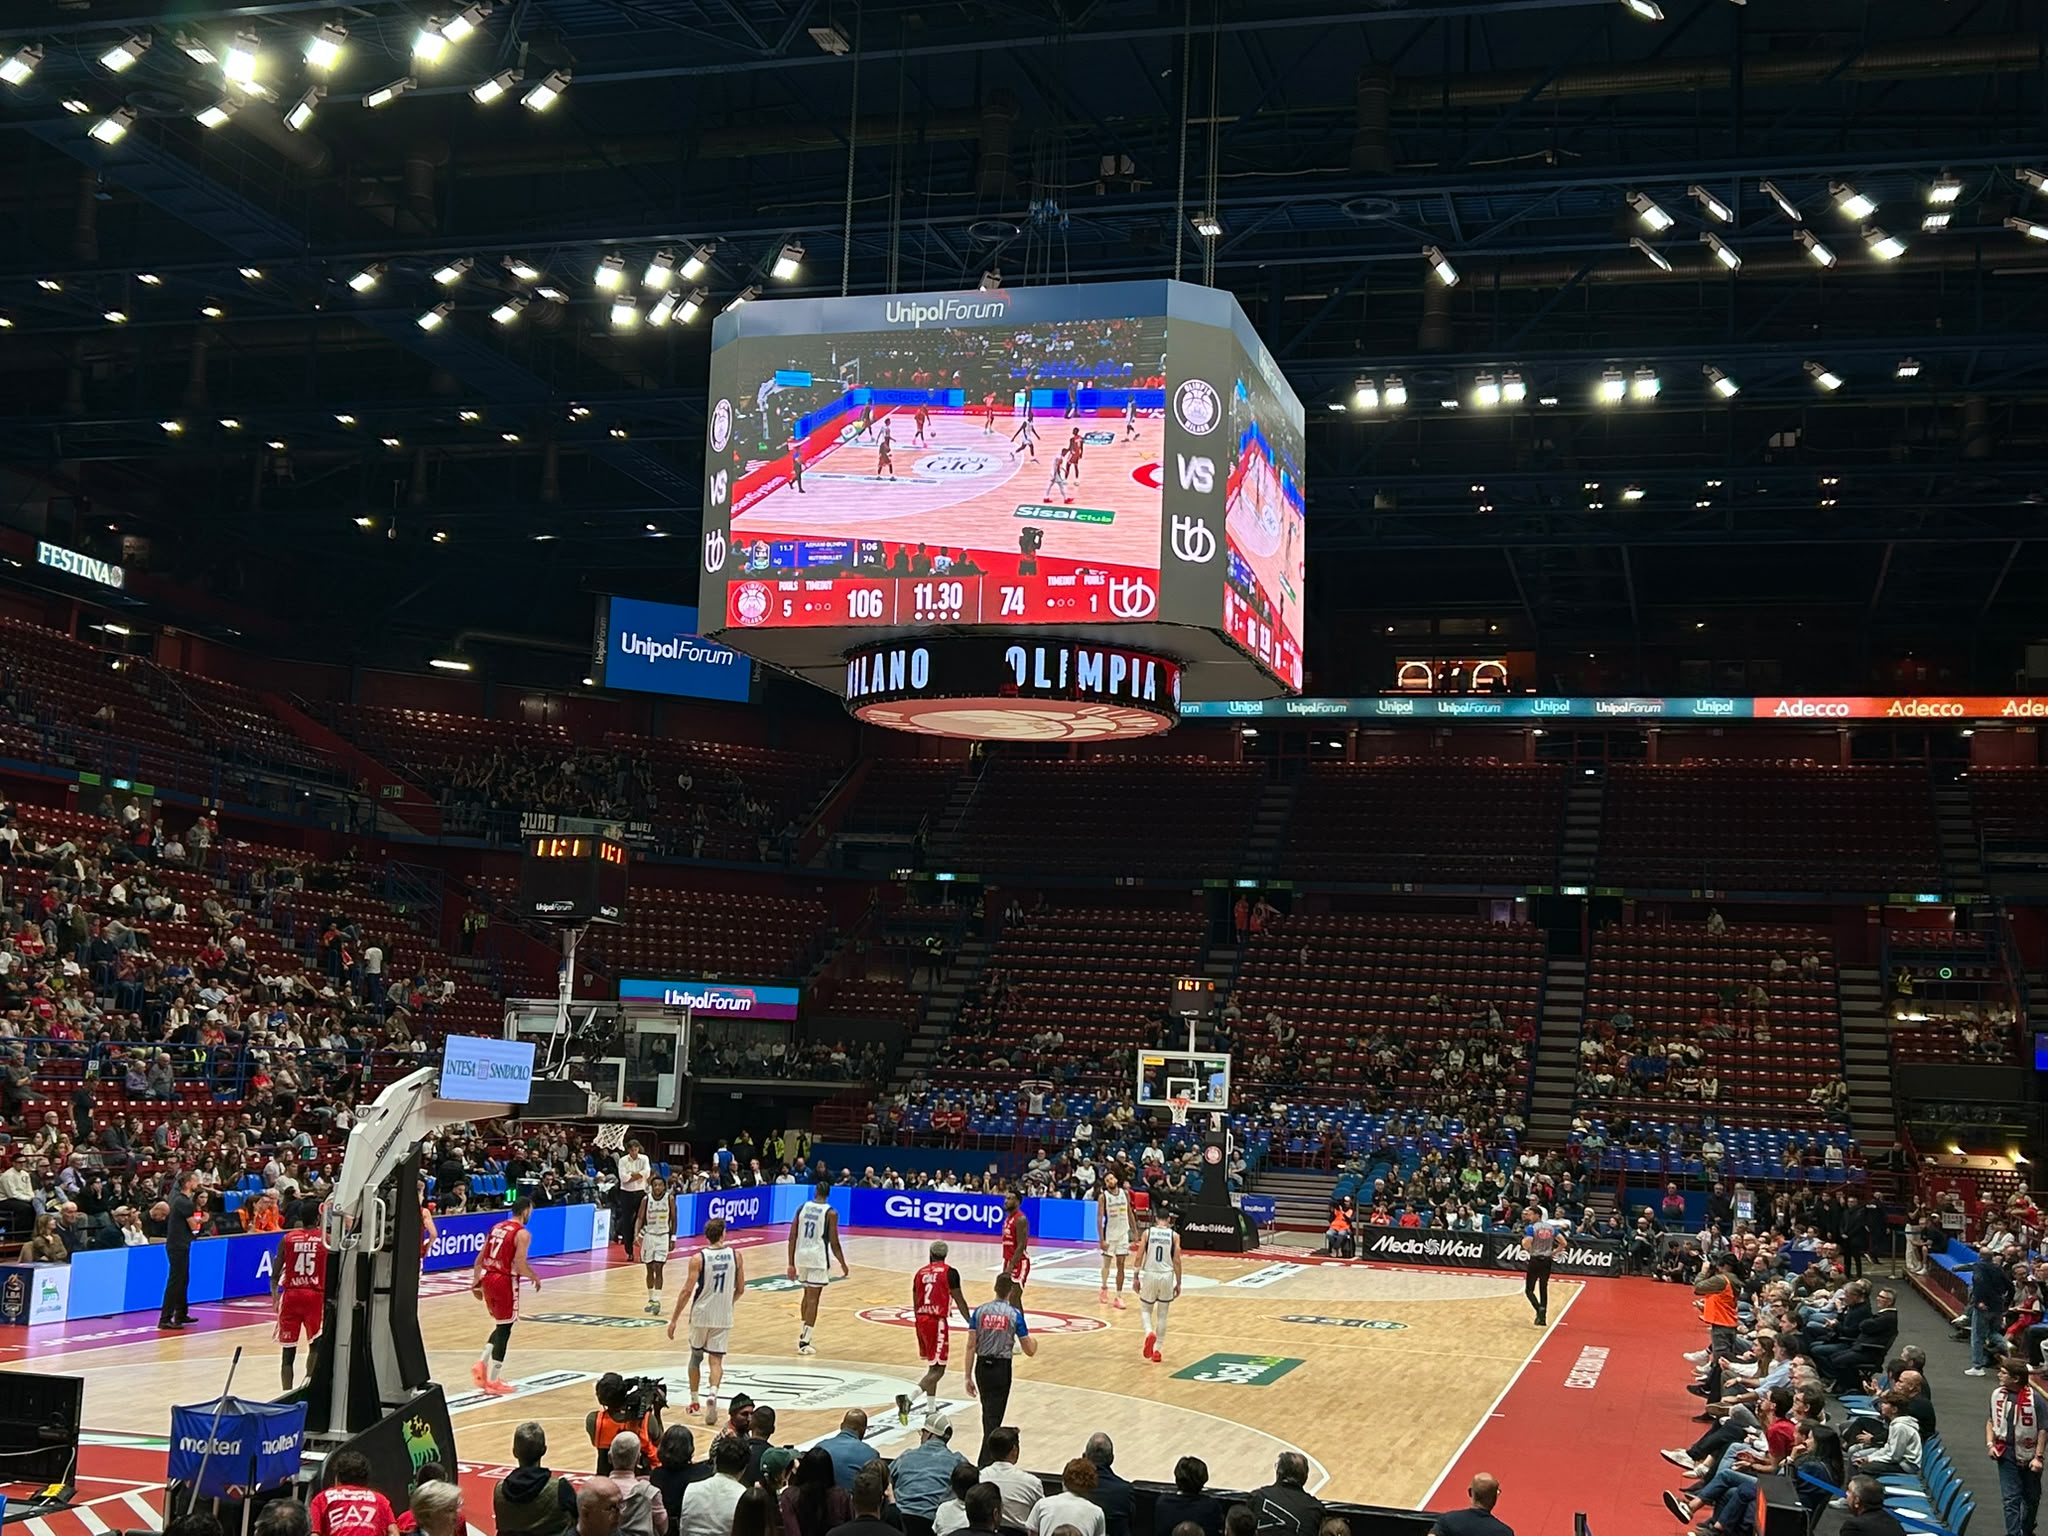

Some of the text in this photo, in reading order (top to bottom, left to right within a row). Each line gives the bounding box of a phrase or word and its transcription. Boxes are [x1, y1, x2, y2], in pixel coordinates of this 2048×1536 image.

[886, 301, 1004, 328] UnipolForum
[1177, 453, 1215, 493] VS
[709, 469, 727, 506] VS
[862, 542, 878, 551] 106
[39, 542, 110, 585] FESTINA
[863, 555, 875, 563] 74
[847, 589, 882, 618] 106
[914, 582, 963, 610] 11.30
[1000, 586, 1024, 615] 74
[1090, 594, 1097, 613] 1
[783, 599, 792, 617] 5
[621, 632, 733, 665] UnipolForum
[1230, 701, 1262, 714] Unipol
[1287, 702, 1346, 715] UnipolForum
[1379, 700, 1413, 714] Unipol
[1438, 702, 1500, 715] UnipolForum
[1534, 700, 1570, 714] Unipol
[1596, 702, 1660, 715] UnipolForum
[1697, 700, 1733, 714] Unipol
[1773, 700, 1849, 717] Adecco
[1887, 700, 1963, 717] Adecco
[90, 1060, 99, 1069] 22
[446, 1059, 475, 1076] INTESA
[804, 1221, 815, 1238] 13
[489, 1236, 504, 1259] 17
[1156, 1246, 1163, 1262] 0
[294, 1253, 316, 1276] 45
[713, 1272, 725, 1293] 11
[924, 1283, 933, 1304] 2
[329, 1505, 377, 1526] EA7
